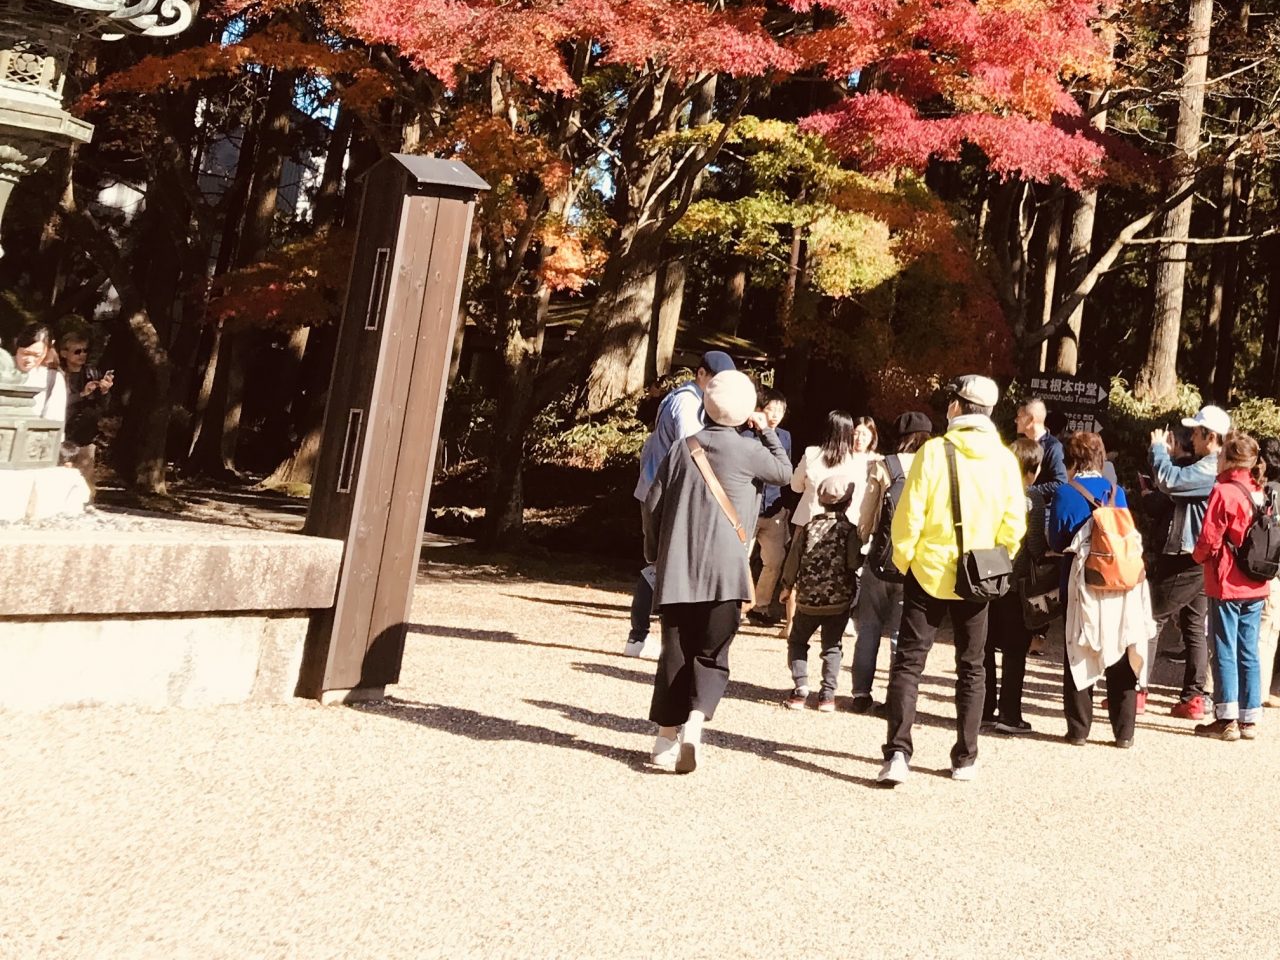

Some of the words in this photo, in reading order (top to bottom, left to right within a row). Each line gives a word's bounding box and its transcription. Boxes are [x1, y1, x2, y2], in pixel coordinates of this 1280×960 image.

[1050, 378, 1097, 396] 根本中堂
[1075, 395, 1096, 404] Temple
